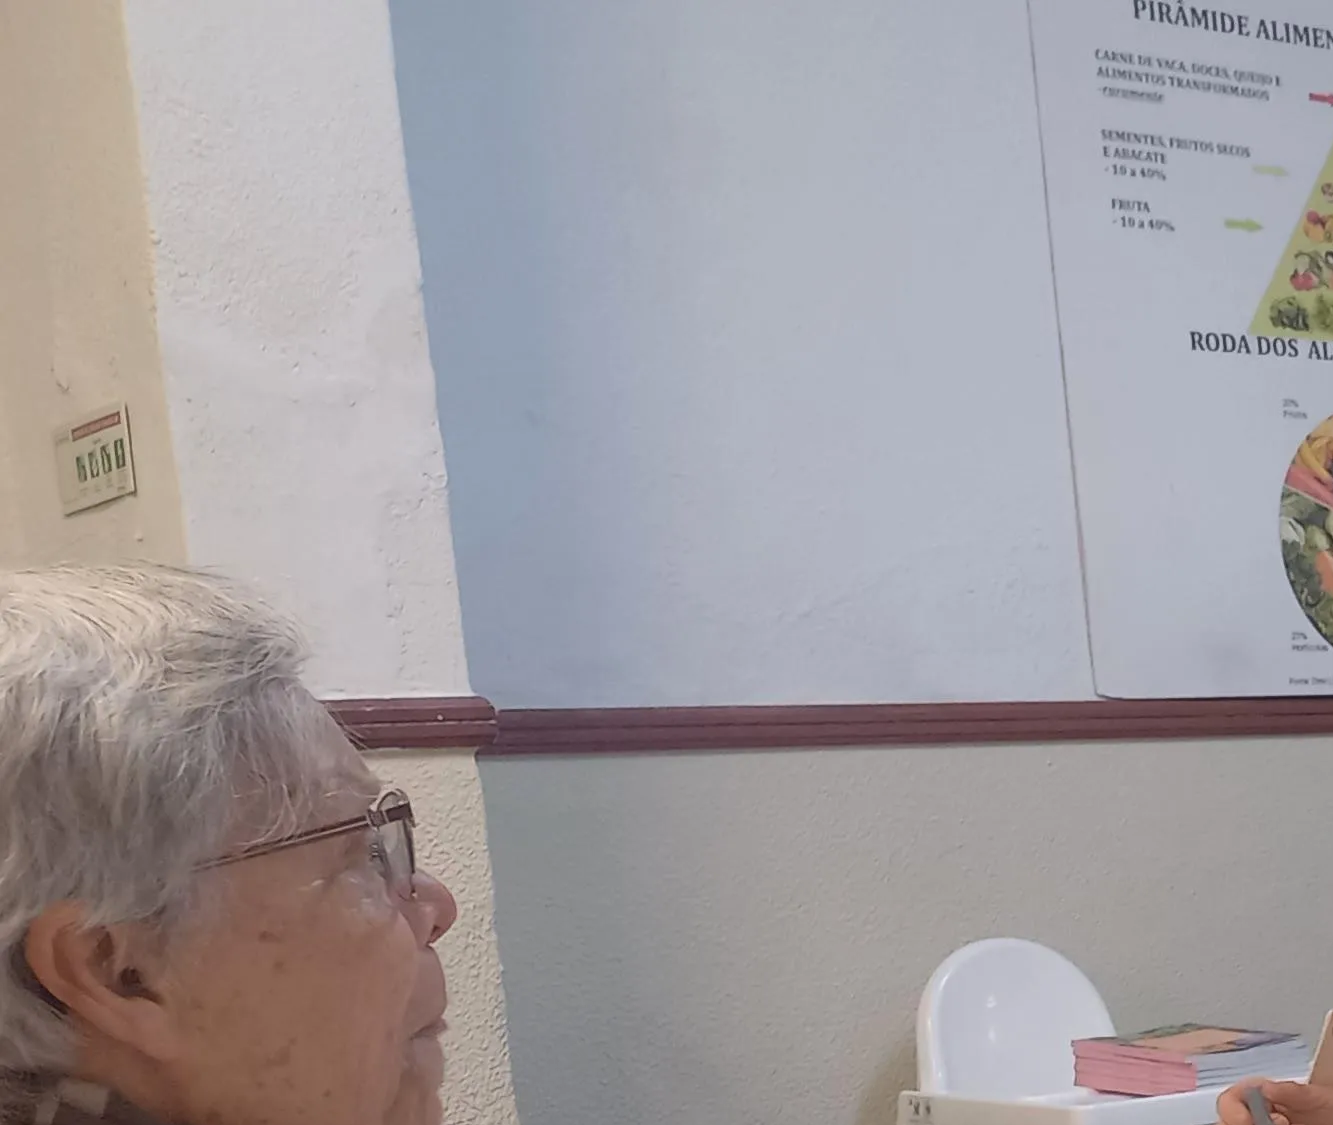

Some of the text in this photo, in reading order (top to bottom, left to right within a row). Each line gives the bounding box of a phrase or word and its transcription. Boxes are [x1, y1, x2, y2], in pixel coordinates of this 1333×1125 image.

[1133, 0, 1250, 37] PIRÂMIDE
[1095, 48, 1135, 66] CARNE
[1137, 54, 1152, 67] DE
[1096, 66, 1270, 101] ALIMENTOS TRANSFORMADOS
[1103, 145, 1167, 165] E ABACATE
[1169, 136, 1214, 152] FRUTOS
[1216, 142, 1251, 158] SECOS
[1111, 198, 1151, 213] FRUTA
[1189, 331, 1252, 355] RODA
[1256, 336, 1299, 358] DOS
